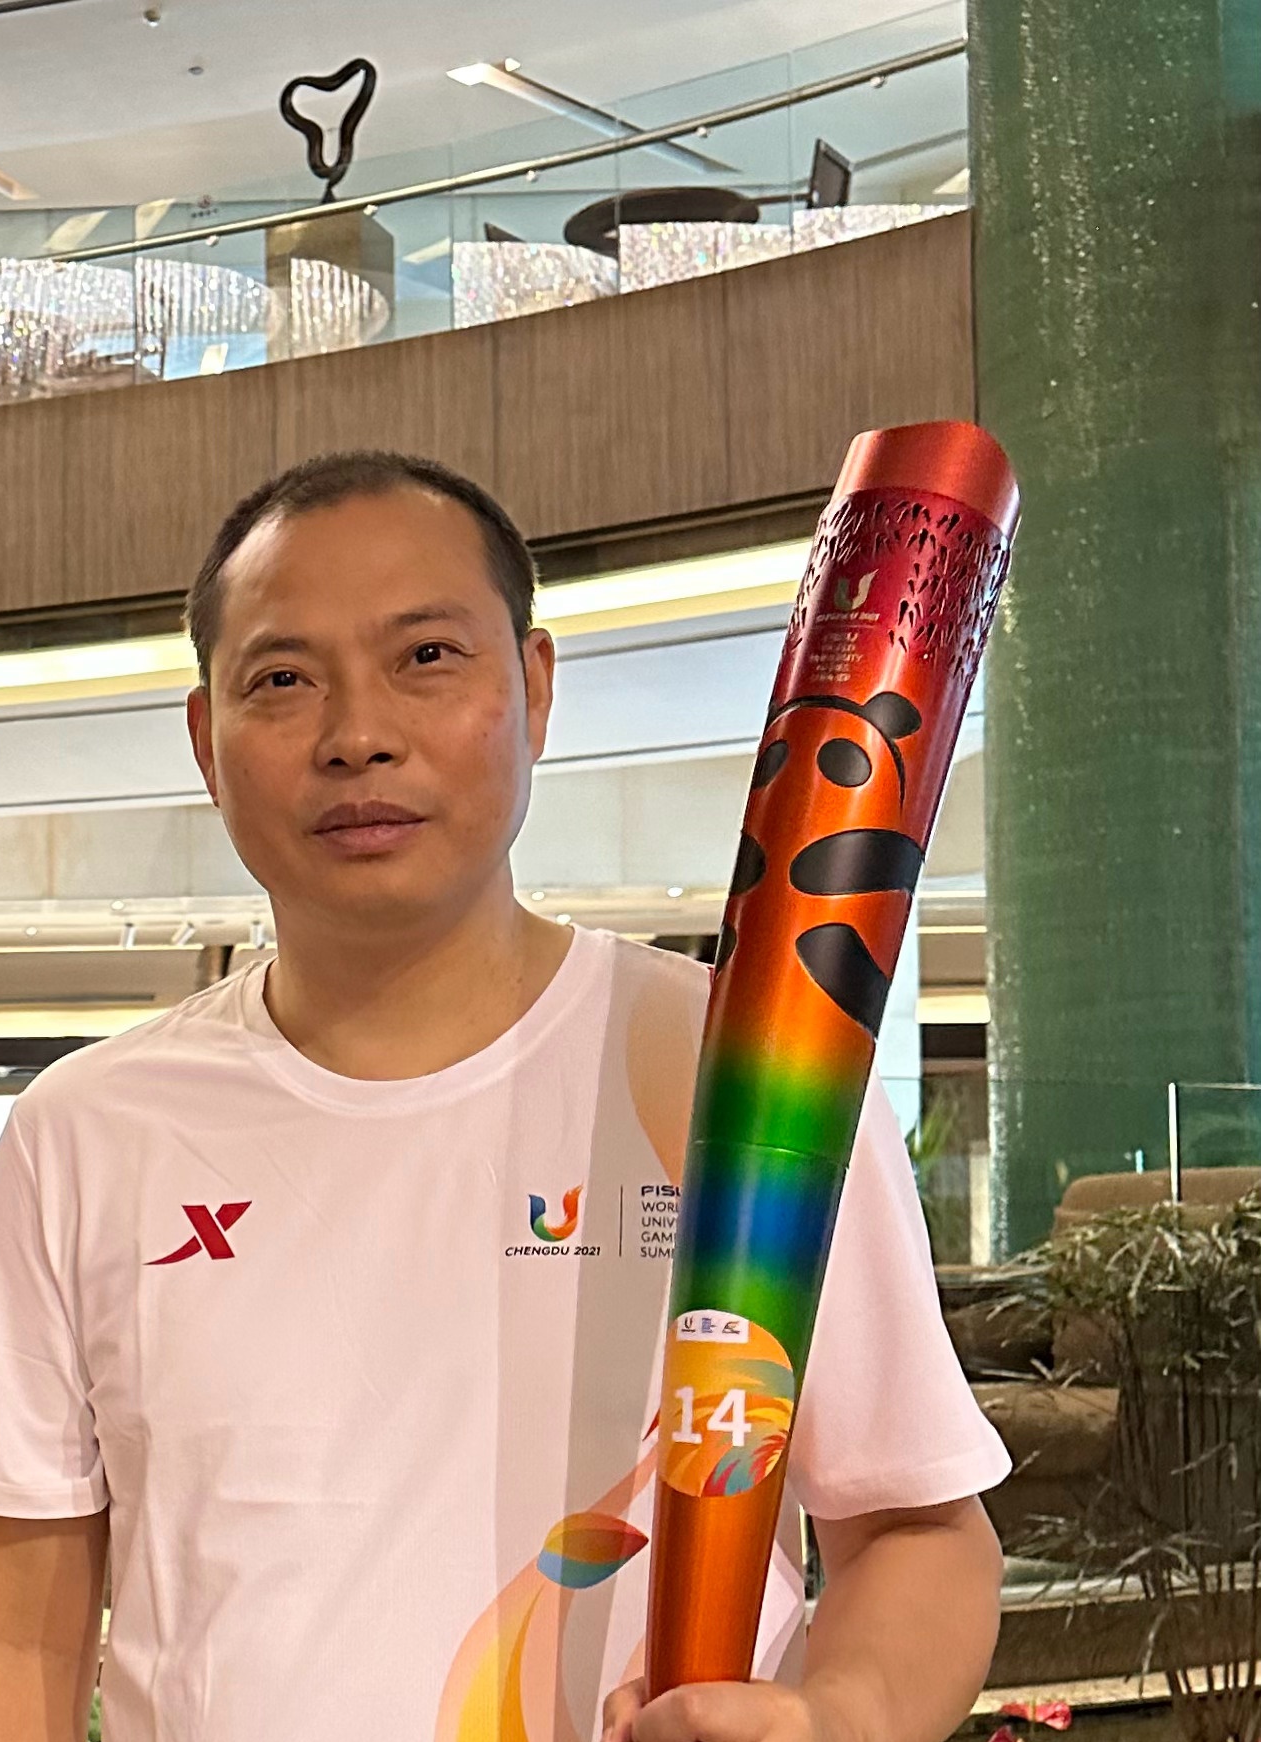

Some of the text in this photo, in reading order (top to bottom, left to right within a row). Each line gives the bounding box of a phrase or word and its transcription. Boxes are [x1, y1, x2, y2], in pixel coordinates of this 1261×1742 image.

[641, 1201, 678, 1212] WORL
[641, 1216, 675, 1228] UNIV
[641, 1231, 673, 1243] GAM
[505, 1246, 601, 1257] CHENGDU 2021
[640, 1246, 673, 1259] SUM
[672, 1385, 752, 1447] 14
